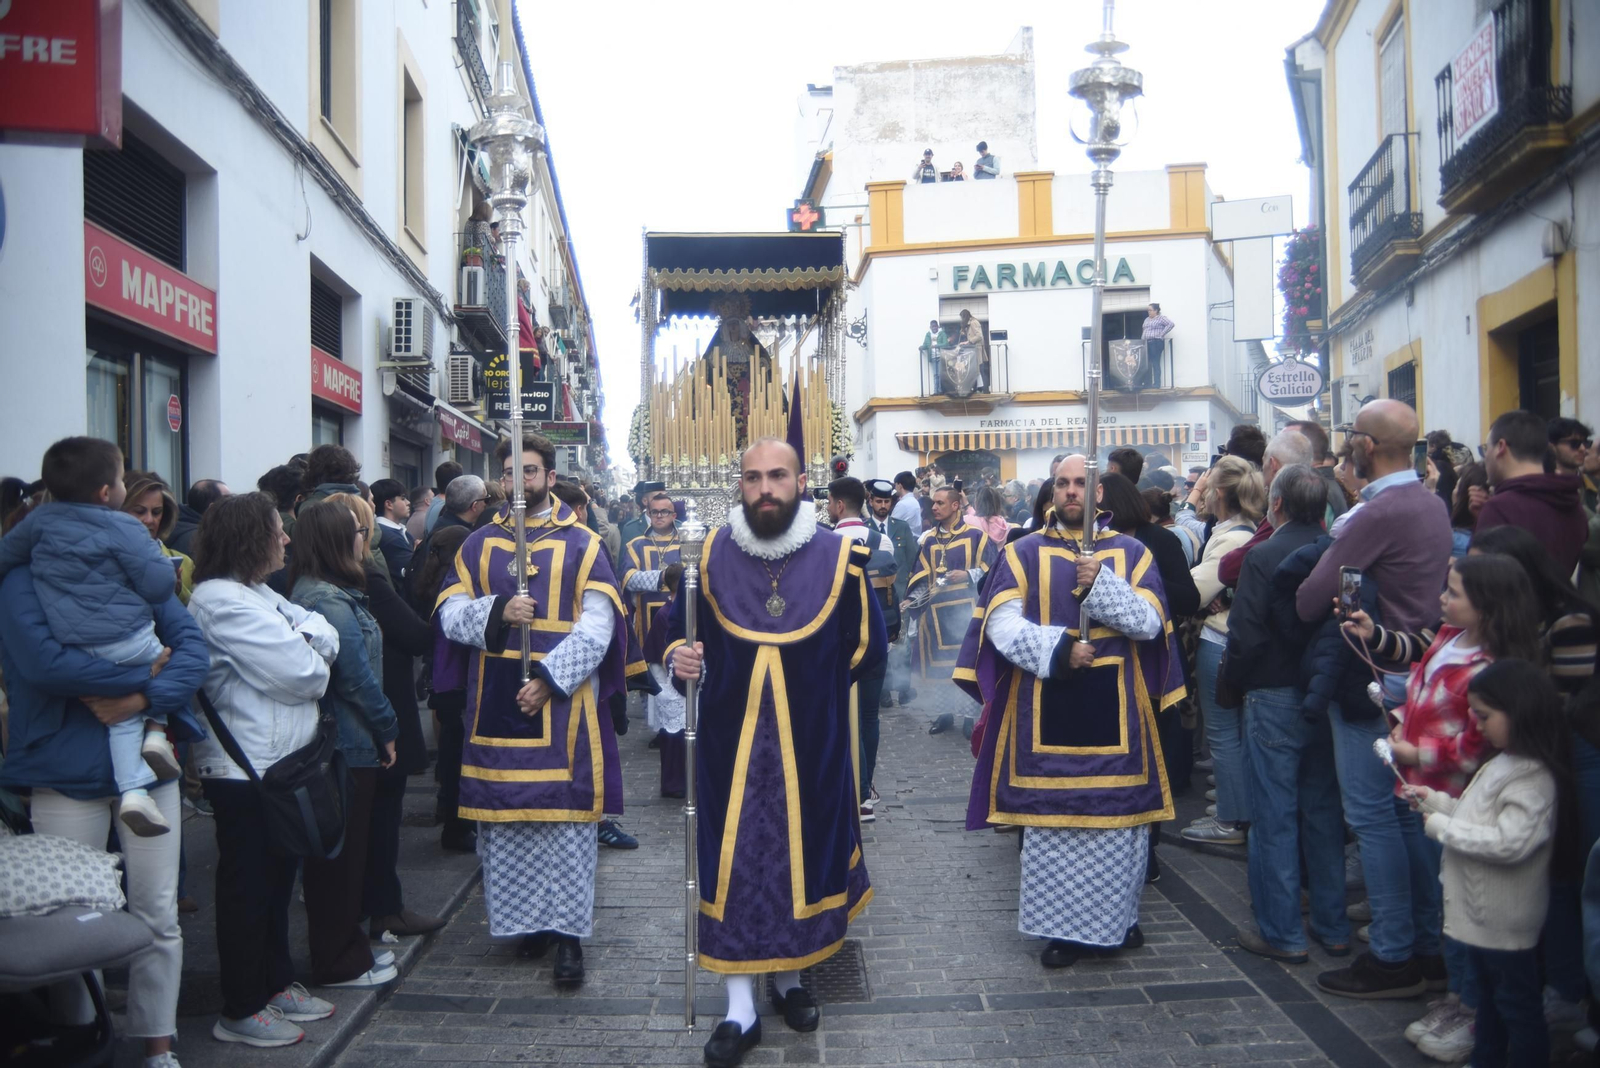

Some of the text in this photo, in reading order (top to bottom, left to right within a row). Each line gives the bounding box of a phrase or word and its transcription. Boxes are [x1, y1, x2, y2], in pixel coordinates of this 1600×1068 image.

[953, 257, 1135, 291] FARMACIA
[122, 259, 213, 336] MAPFRE
[323, 363, 361, 404] MAPFRE
[1267, 371, 1315, 383] Estrella
[1269, 382, 1312, 395] Galicia
[980, 416, 1117, 428] FARMACIA DEL REAEJO
